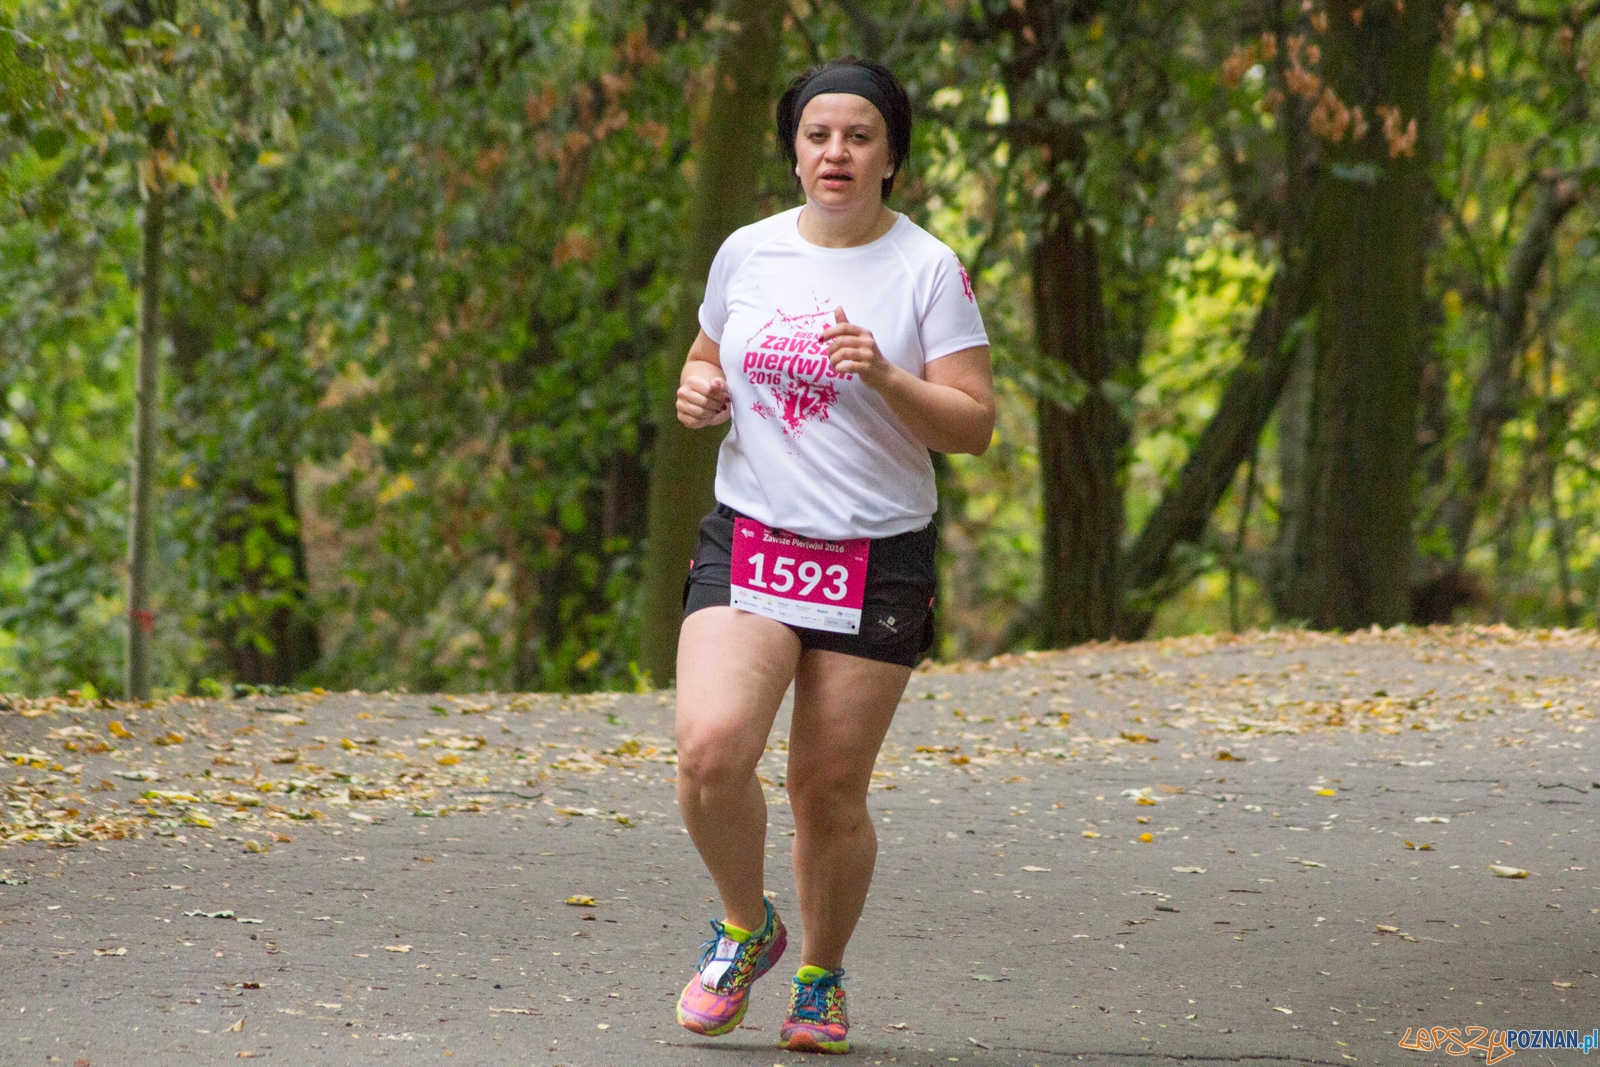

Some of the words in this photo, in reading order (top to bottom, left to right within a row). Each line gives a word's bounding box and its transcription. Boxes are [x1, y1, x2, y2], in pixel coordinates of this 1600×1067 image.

[760, 335, 830, 357] zaws
[749, 371, 782, 385] 2016
[763, 533, 790, 546] Zawsze
[824, 543, 845, 553] 2016
[748, 553, 849, 601] 1593
